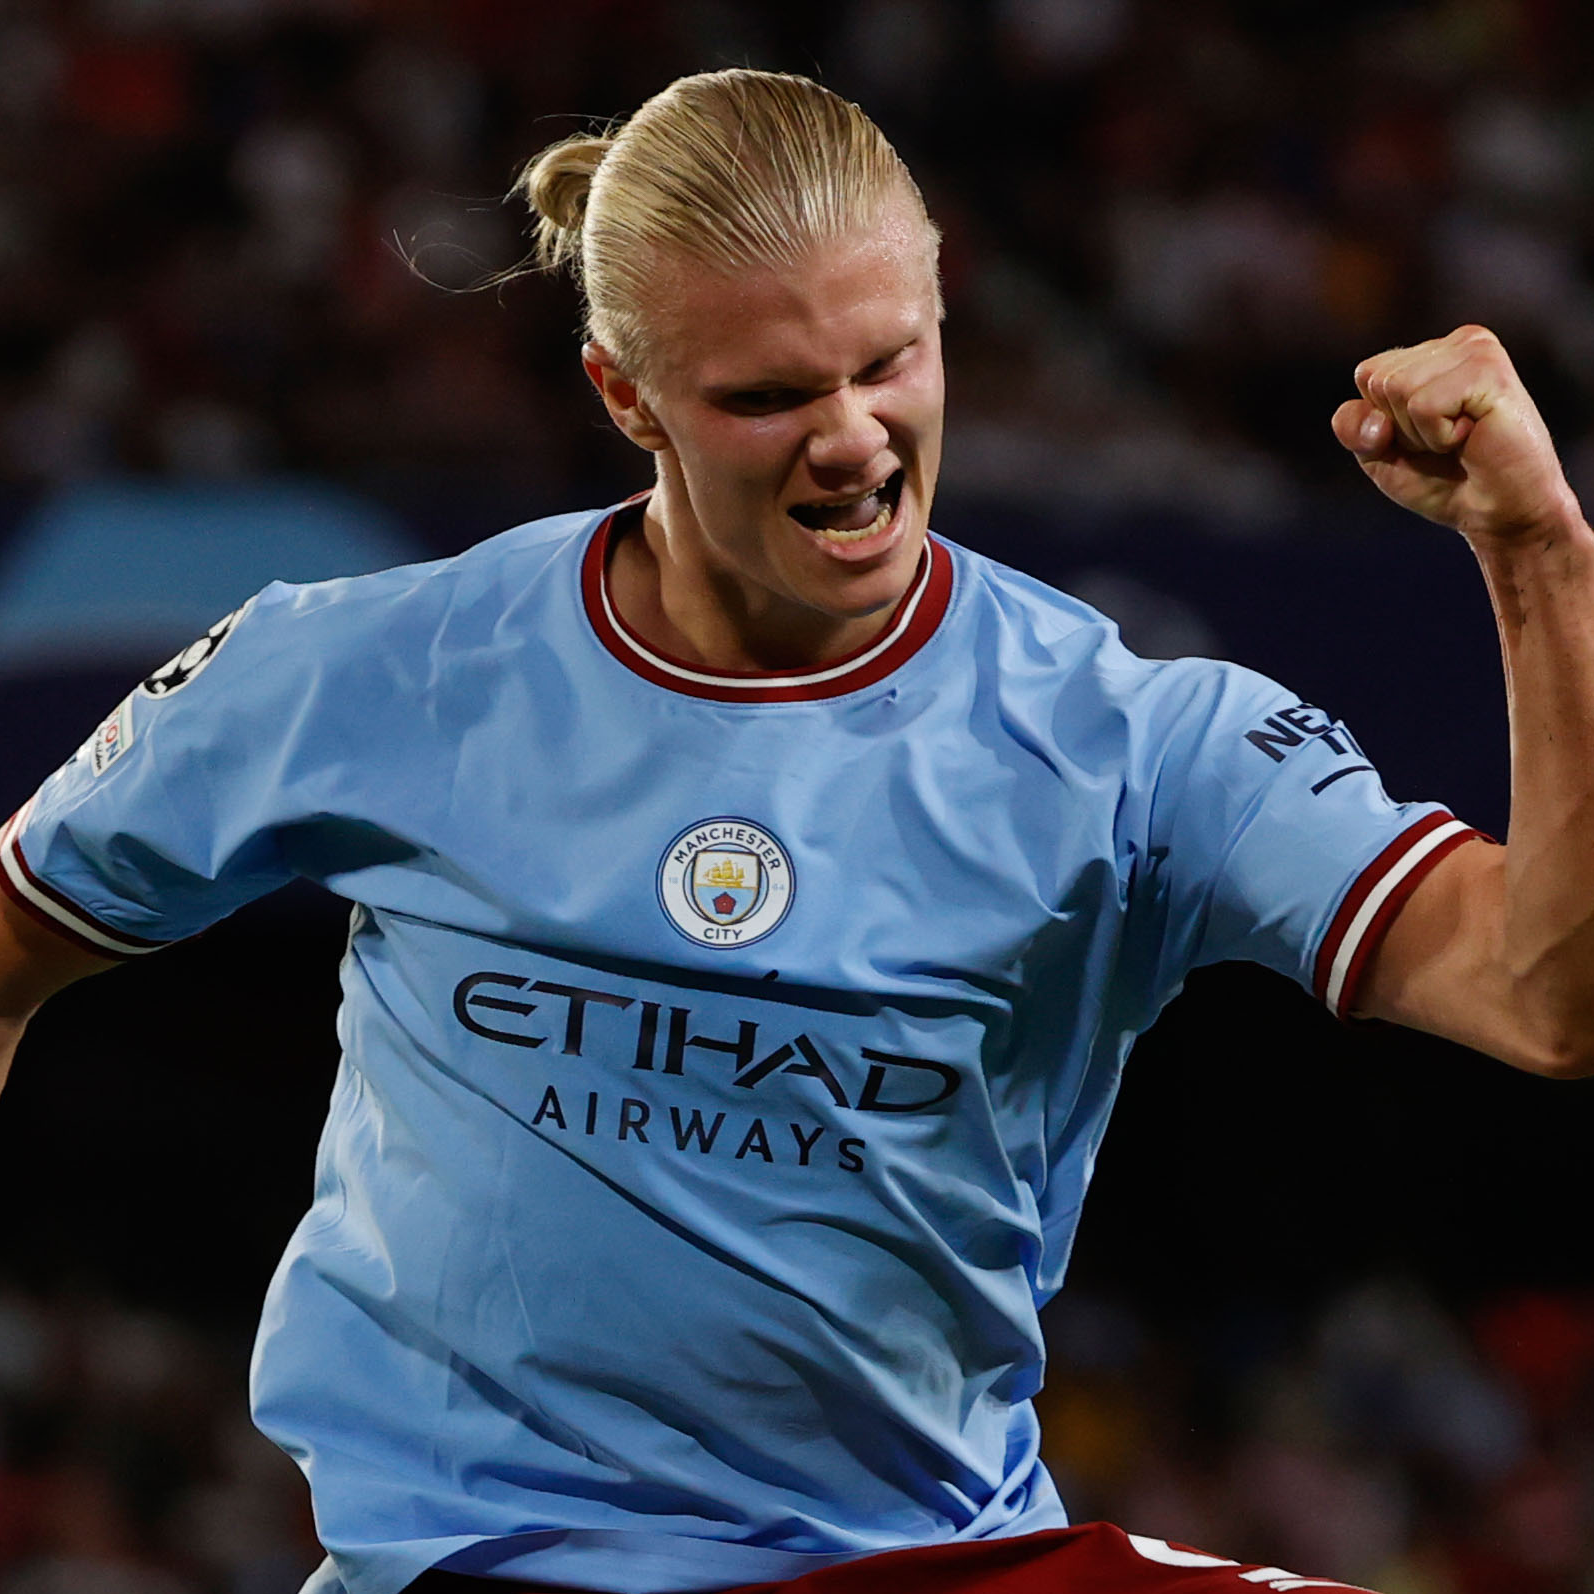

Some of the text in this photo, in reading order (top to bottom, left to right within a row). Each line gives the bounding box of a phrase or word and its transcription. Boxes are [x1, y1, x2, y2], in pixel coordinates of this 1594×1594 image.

[674, 827, 781, 870] MANCHESTER
[703, 927, 743, 940] CITY
[452, 969, 962, 1114] ETIHAD
[533, 1084, 866, 1173] AIRWAYS
